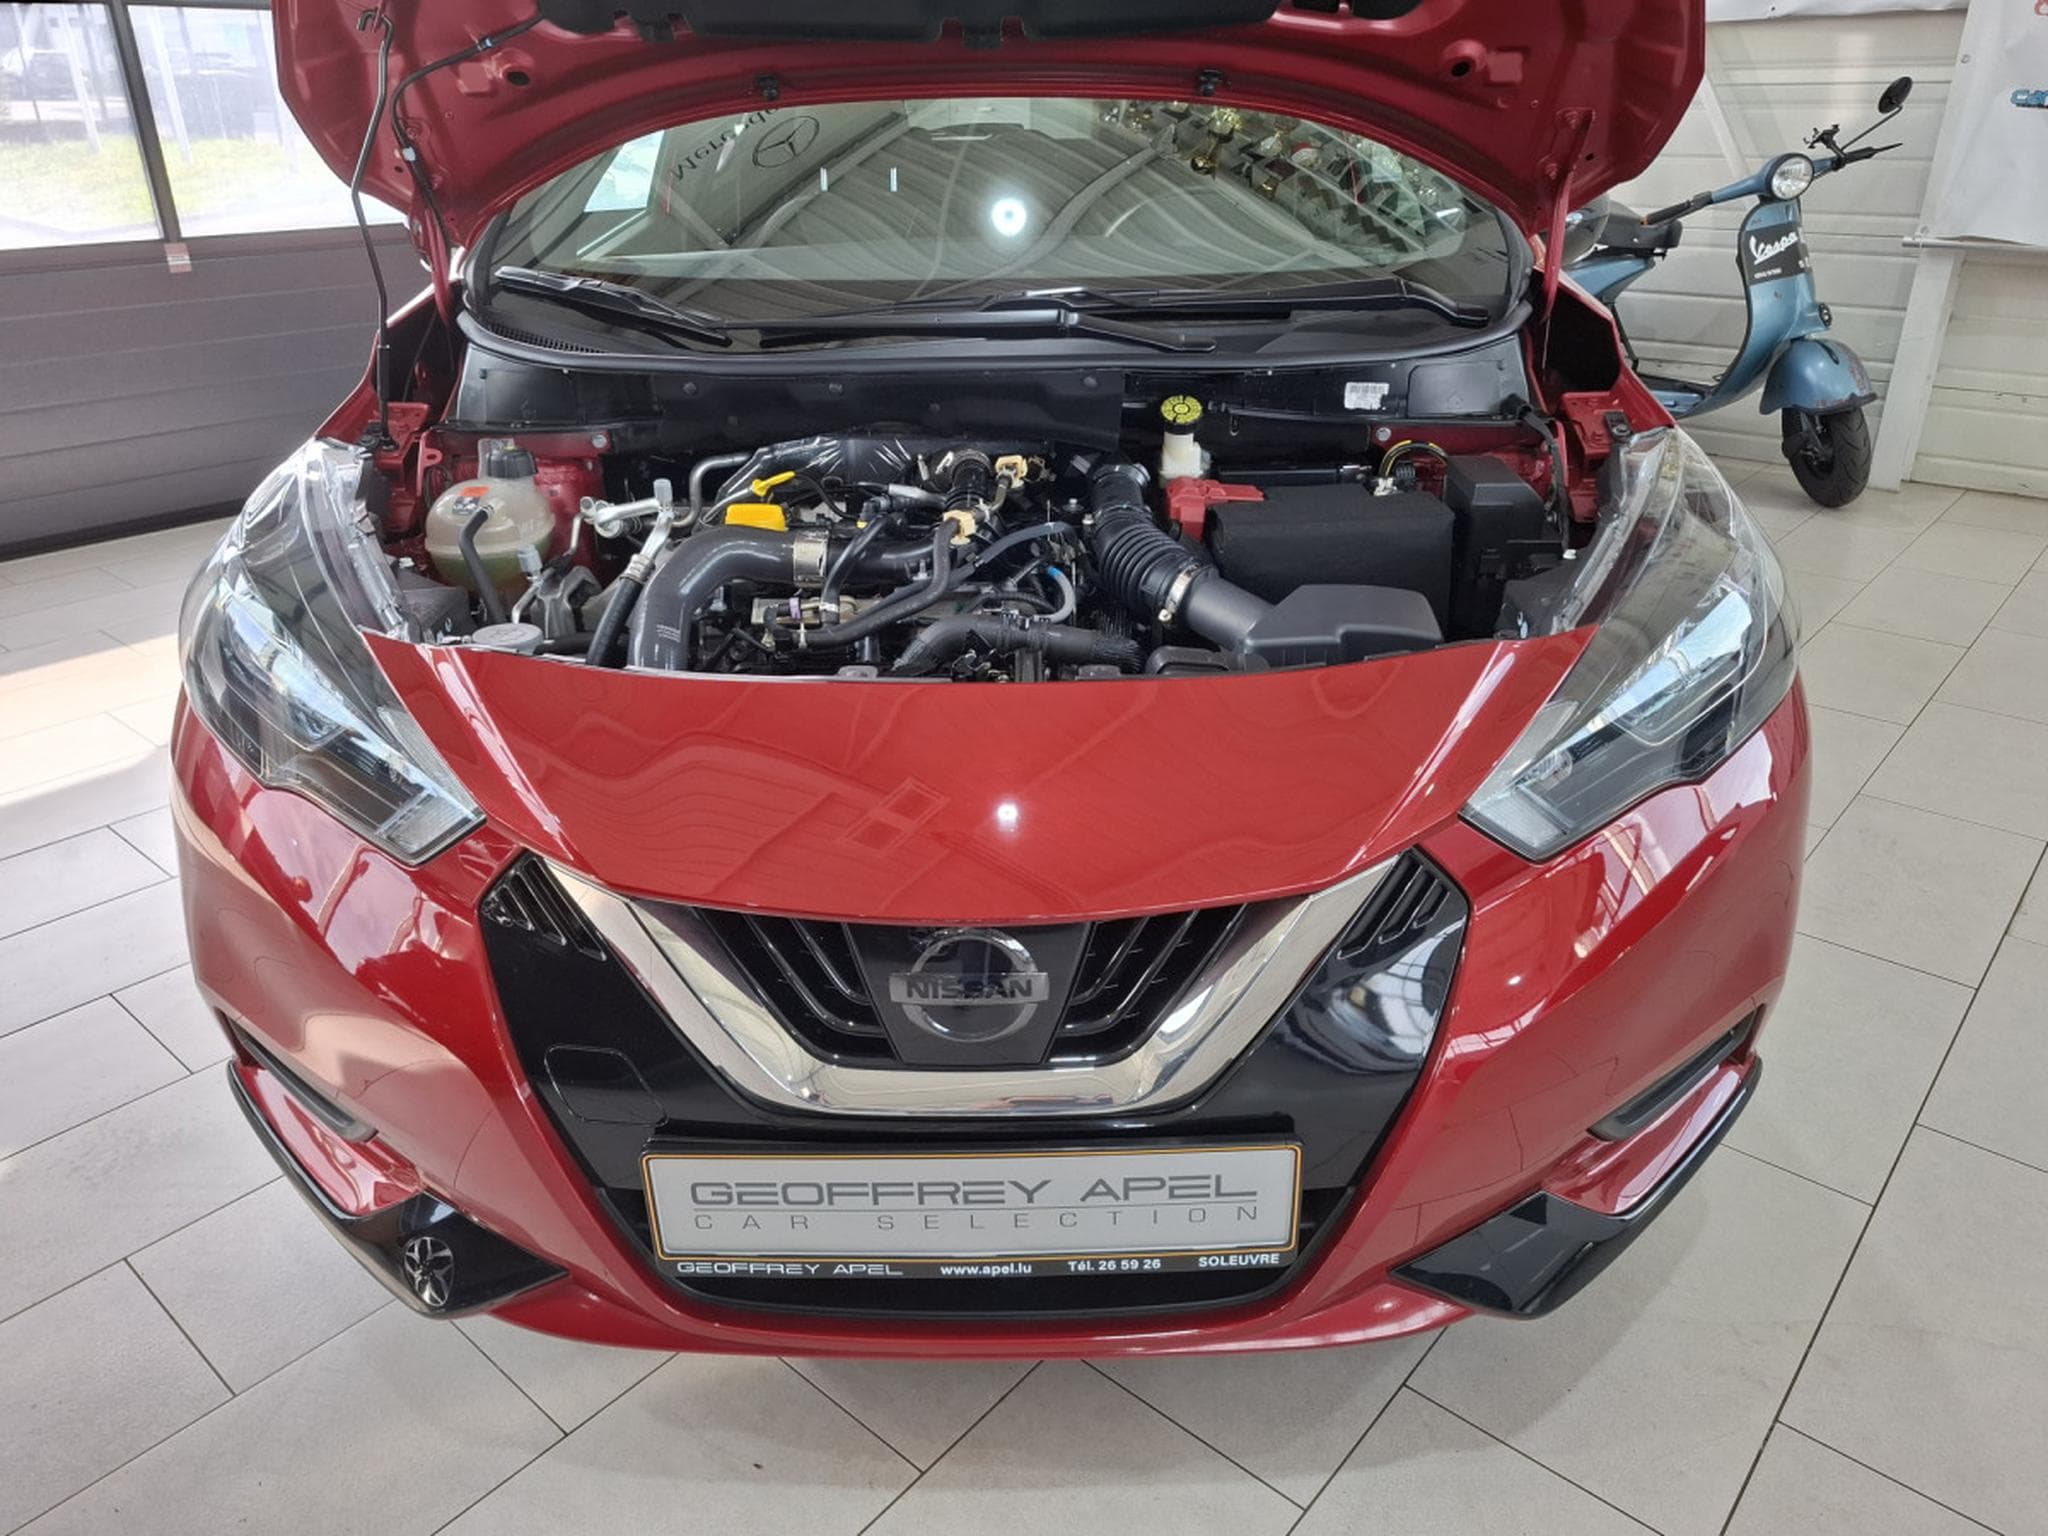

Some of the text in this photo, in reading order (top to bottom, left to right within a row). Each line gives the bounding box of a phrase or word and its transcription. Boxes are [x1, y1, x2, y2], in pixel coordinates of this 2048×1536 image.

[1748, 231, 1798, 265] Vespa
[690, 1174, 1258, 1206] GEOFFREY APEL
[694, 1206, 1258, 1231] CAR SELECTION
[676, 1253, 1281, 1276] GEOFFREY APEL www.apel.lu Tél. 26 59 26 SOLEUVRE
